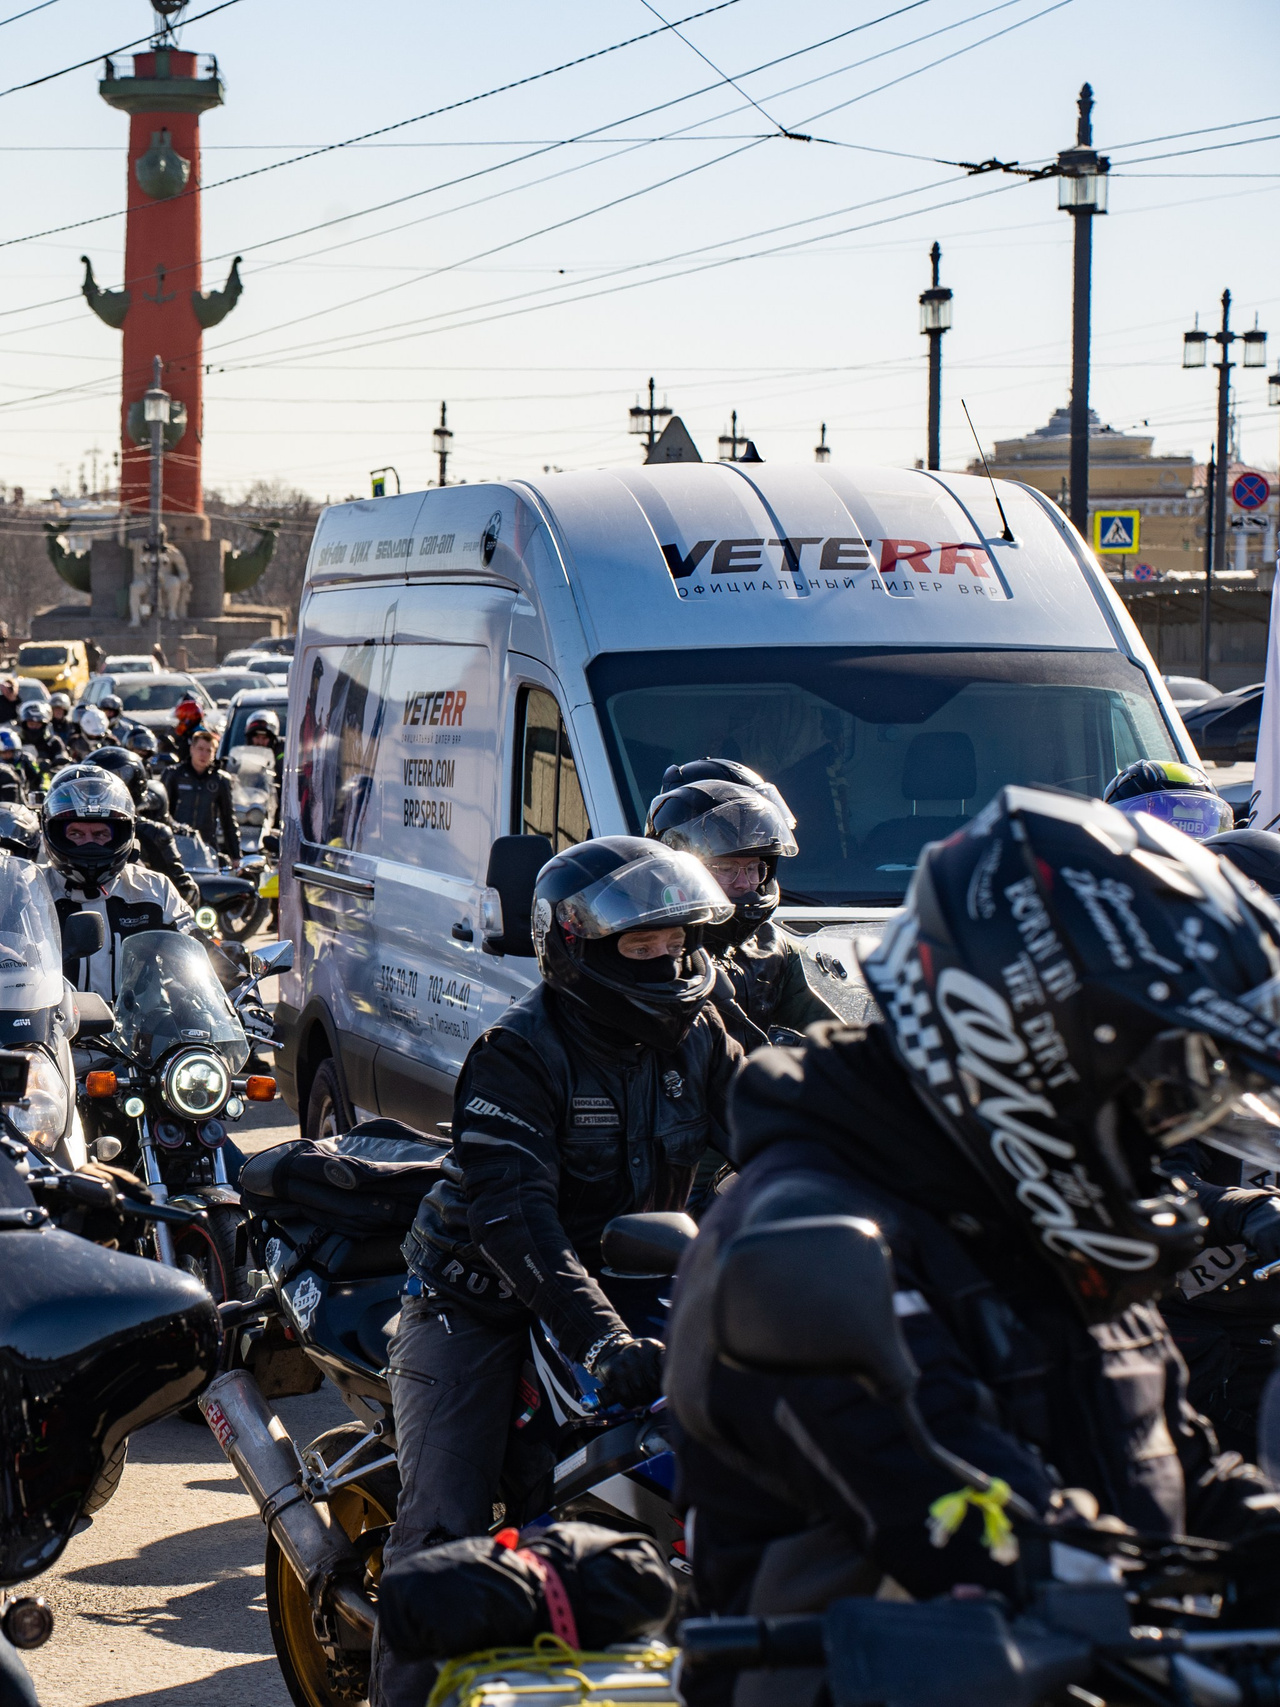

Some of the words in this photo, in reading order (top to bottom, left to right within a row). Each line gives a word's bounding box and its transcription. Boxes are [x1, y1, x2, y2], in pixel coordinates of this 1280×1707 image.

[660, 536, 991, 579] VETERR
[678, 576, 857, 599] ОФИЦИАЛЬНЫЙ
[871, 579, 943, 594] ДИЛЕР
[959, 583, 999, 598] BRP
[402, 690, 467, 727] VETERR
[403, 758, 456, 788] VETERR.COM
[403, 798, 453, 831] BRP.SPB.RU
[1171, 819, 1205, 834] SHOEI
[427, 974, 471, 1012] 702-40-40
[12, 1018, 32, 1028] GIVI
[1189, 1245, 1236, 1287] RU
